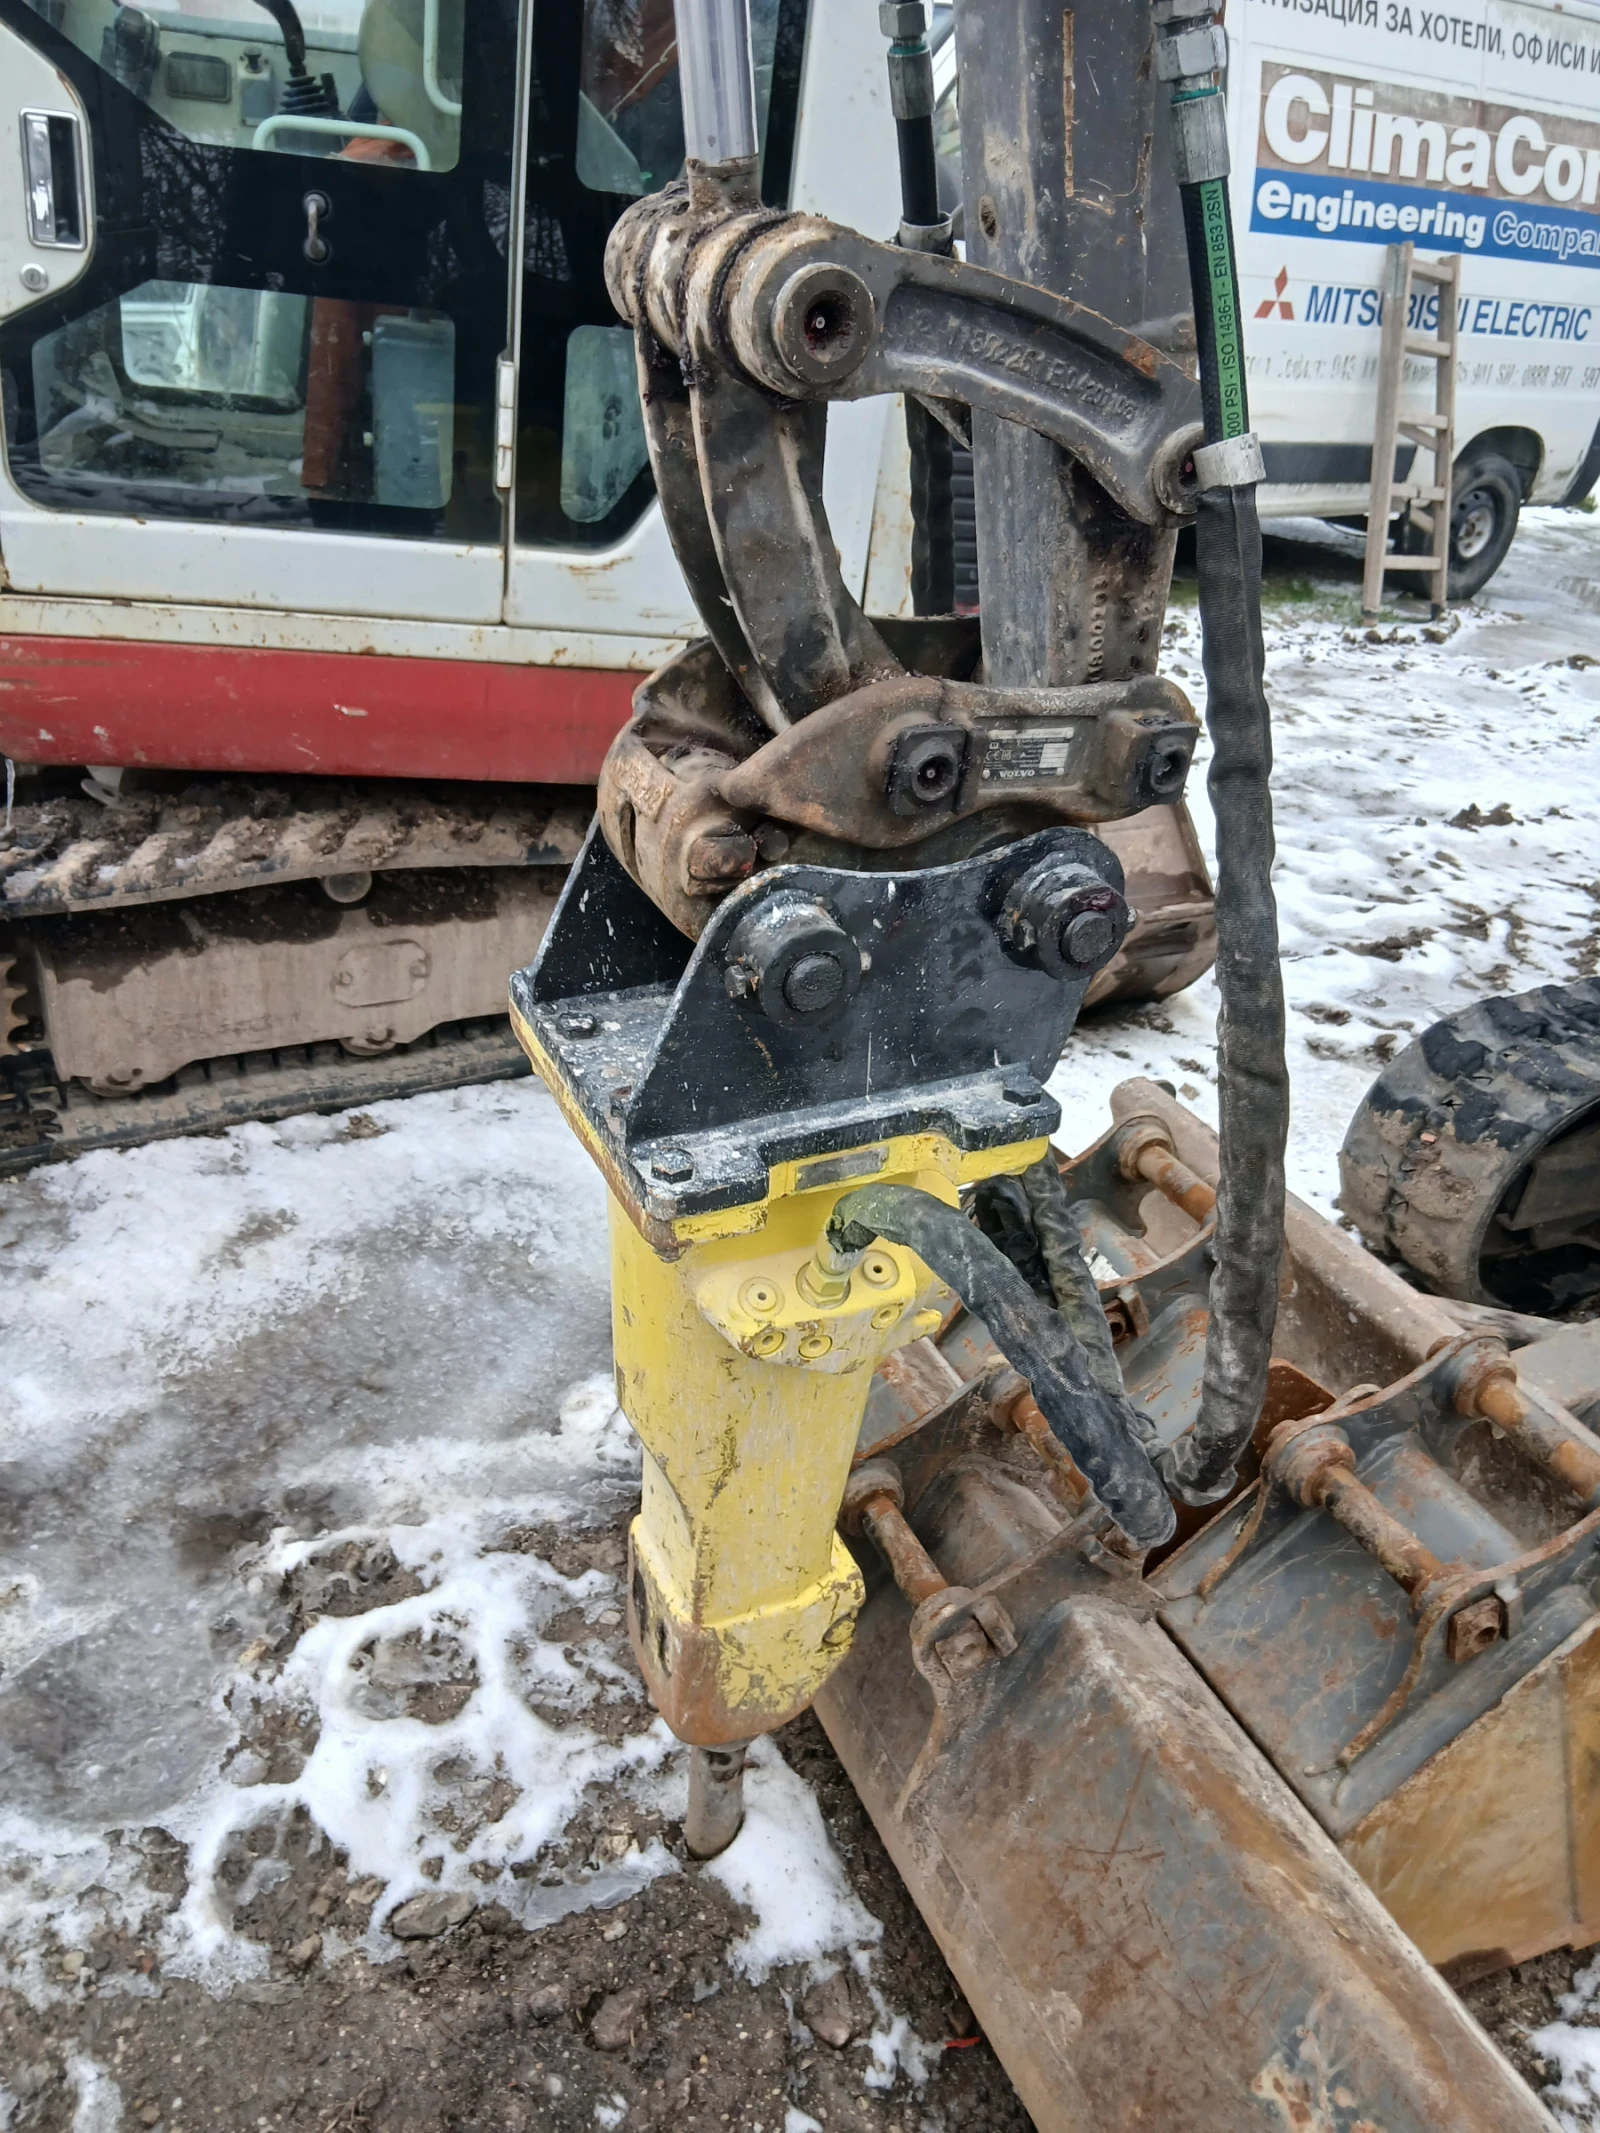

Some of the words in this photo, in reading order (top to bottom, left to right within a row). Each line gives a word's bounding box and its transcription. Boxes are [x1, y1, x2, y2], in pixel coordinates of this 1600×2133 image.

[1385, 3, 1413, 36] ЗА
[1419, 11, 1505, 60] ХОТЕЛИ,
[1512, 32, 1585, 71] ОФИСИ
[1205, 189, 1222, 222] 2SN
[1257, 180, 1486, 248] engineering
[1493, 211, 1600, 260] Compa
[1210, 225, 1225, 253] 853
[1213, 256, 1228, 278] EN
[1217, 293, 1233, 340] 1436-1
[1471, 298, 1592, 342] ELECTRIC
[1221, 343, 1236, 371] ISO
[1223, 383, 1239, 408] PSI
[999, 769, 1036, 778] VOLVO
